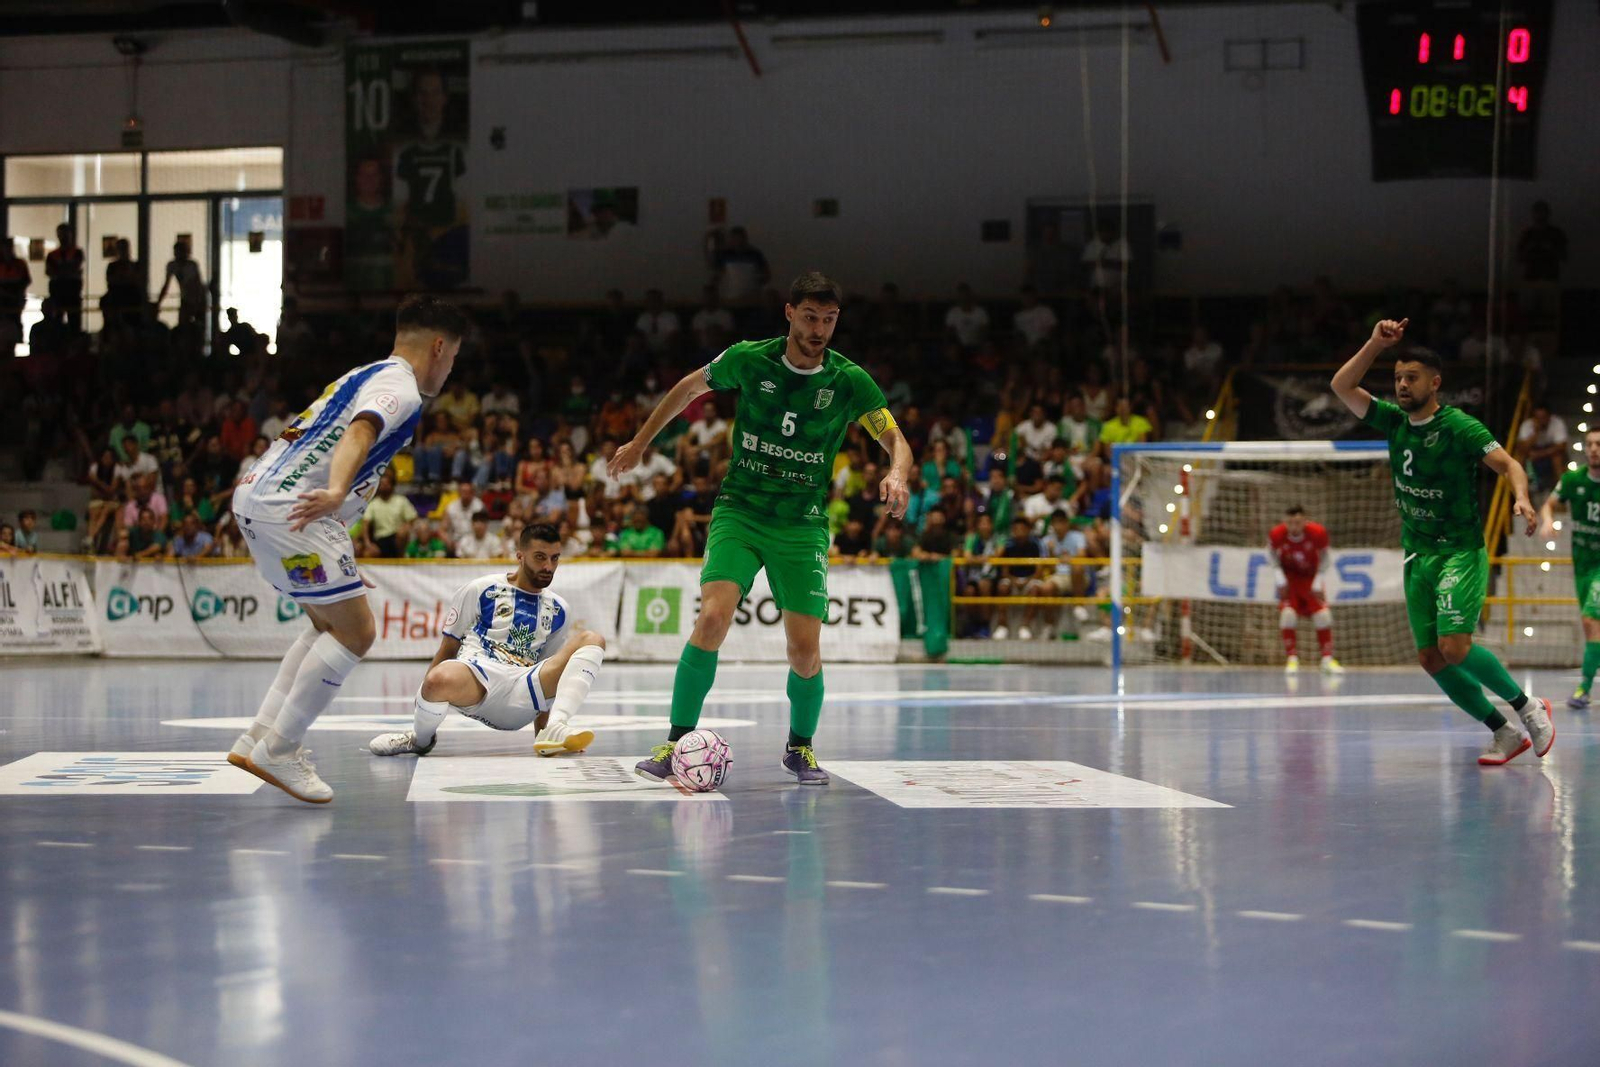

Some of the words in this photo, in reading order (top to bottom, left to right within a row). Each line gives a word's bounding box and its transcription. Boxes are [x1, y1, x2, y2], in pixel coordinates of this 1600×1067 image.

[1418, 32, 1430, 64] 1
[1452, 33, 1465, 61] 1
[1507, 28, 1531, 63] 0
[347, 79, 391, 131] 10
[1389, 88, 1402, 115] 1
[1410, 84, 1496, 117] 08:02
[1507, 85, 1528, 112] 4
[418, 166, 445, 204] 7
[781, 411, 798, 437] 5
[760, 441, 825, 464] BESOCCER
[1403, 449, 1413, 477] 2
[1586, 501, 1600, 522] 12
[107, 586, 173, 622] anp
[191, 586, 258, 624] anp
